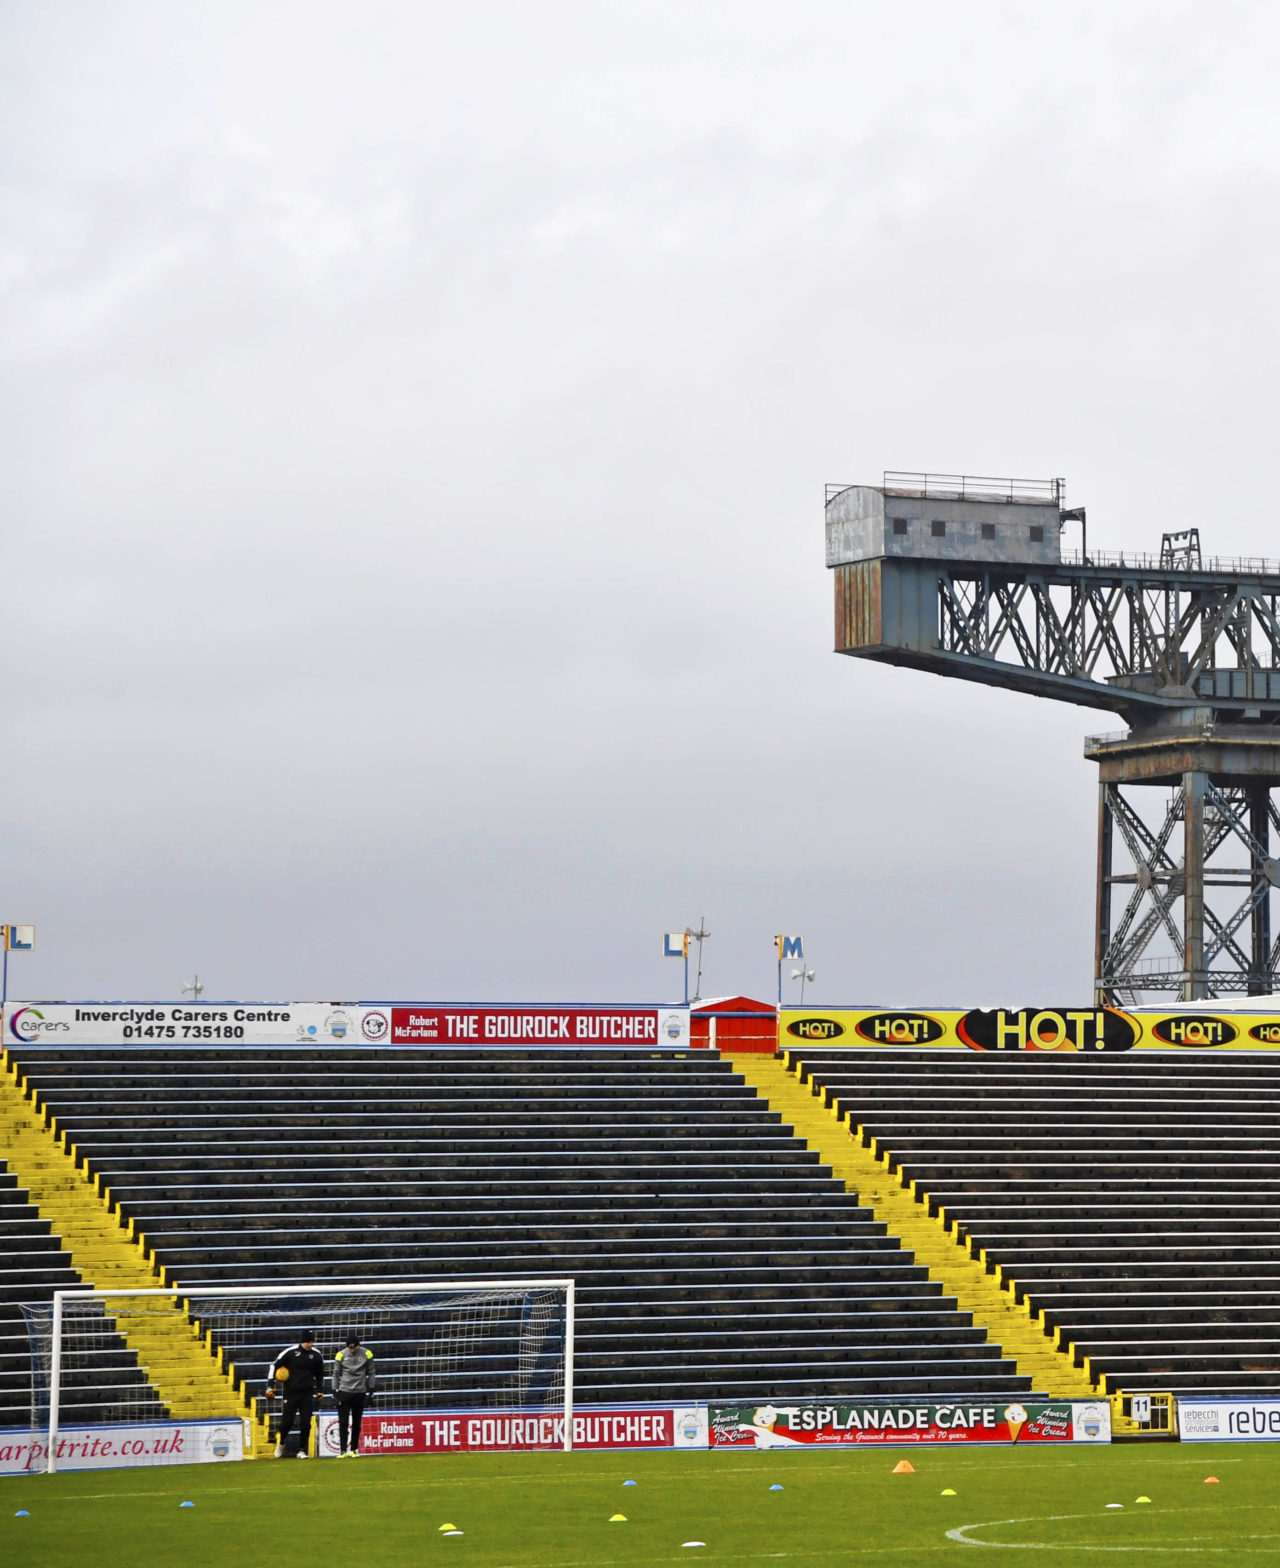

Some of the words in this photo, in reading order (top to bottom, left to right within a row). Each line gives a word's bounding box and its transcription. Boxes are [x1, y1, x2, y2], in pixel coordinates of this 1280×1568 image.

[11, 926, 32, 949] L
[664, 934, 683, 956] L
[782, 937, 803, 958] M
[75, 1009, 165, 1024] Inverclyde
[171, 1009, 228, 1022] Carers
[233, 1009, 290, 1022] Centre
[409, 1015, 438, 1026] Robert
[123, 1026, 175, 1038] 01475
[182, 1026, 244, 1038] 735180
[395, 1026, 438, 1037] McFarlane
[445, 1015, 479, 1038] THE
[484, 1015, 570, 1038] GOUROCK
[576, 1016, 655, 1039] BUTCHER
[799, 1022, 835, 1035] HOT!
[874, 1019, 929, 1039] HOT!
[997, 1010, 1105, 1050] HOT!
[1170, 1021, 1222, 1041] HOT!
[1134, 1399, 1148, 1412] 11
[712, 1412, 740, 1424] Award
[788, 1408, 929, 1430] ESPLANADE
[935, 1408, 996, 1428] CAFE
[1041, 1407, 1069, 1419] Award
[1184, 1410, 1219, 1419] rebecchi
[380, 1422, 414, 1434] Robert
[1036, 1415, 1068, 1428] Winning
[422, 1420, 460, 1446] THE
[467, 1418, 566, 1445] GOUROCK
[573, 1415, 665, 1443] BUTCHER
[815, 1432, 841, 1442] Serving
[843, 1433, 854, 1441] the
[856, 1431, 884, 1442] Greenock
[886, 1432, 920, 1442] community
[938, 1431, 947, 1439] 70
[949, 1432, 968, 1441] years.
[1027, 1424, 1040, 1435] Ice
[1042, 1424, 1067, 1437] Cream
[364, 1435, 414, 1448] McFarlane
